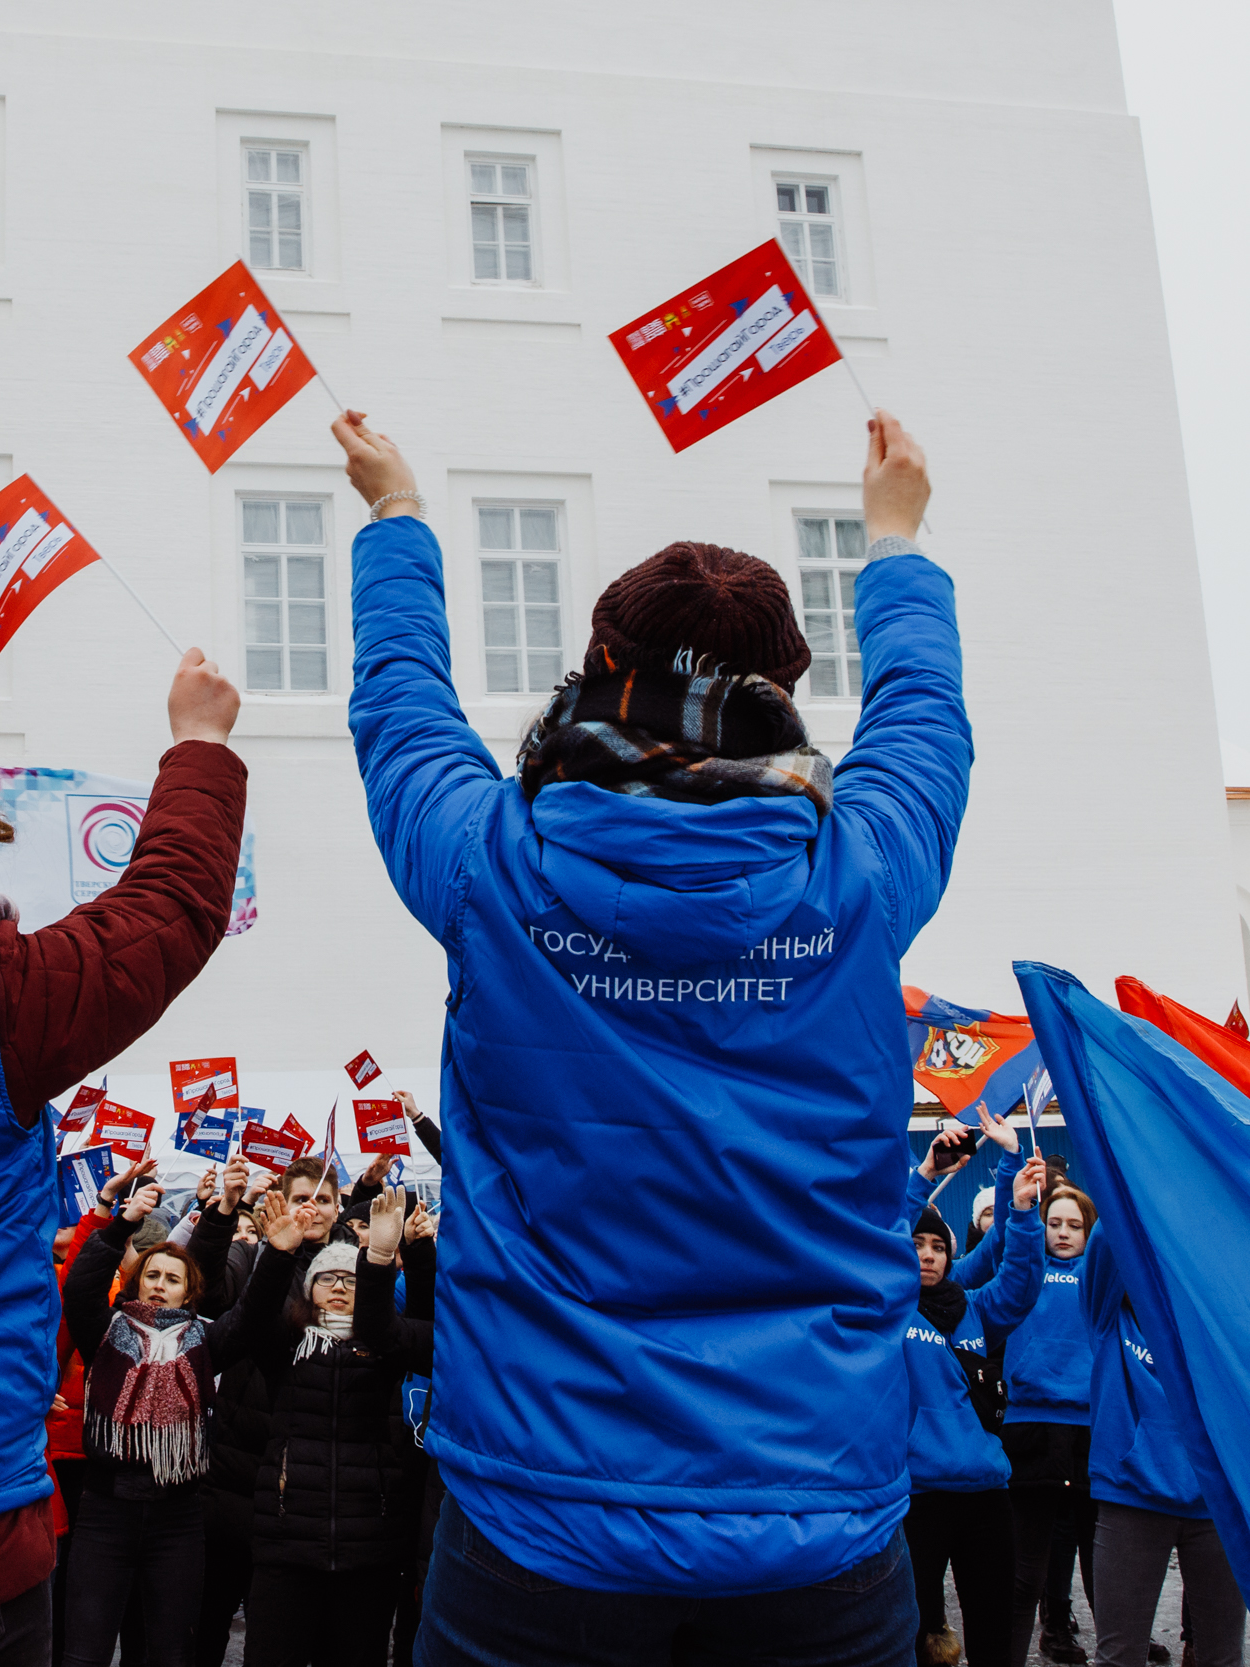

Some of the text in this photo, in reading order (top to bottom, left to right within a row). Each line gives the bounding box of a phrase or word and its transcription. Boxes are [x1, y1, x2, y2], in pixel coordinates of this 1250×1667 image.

[677, 304, 783, 398] #ПрошагайГород
[767, 326, 806, 356] Тверь
[195, 325, 263, 420] #ПрошагайГород
[31, 535, 63, 563] Тверь
[529, 924, 836, 963] ГОСУДННЫЙ
[570, 973, 794, 1003] УНИВЕРСИТЕТ
